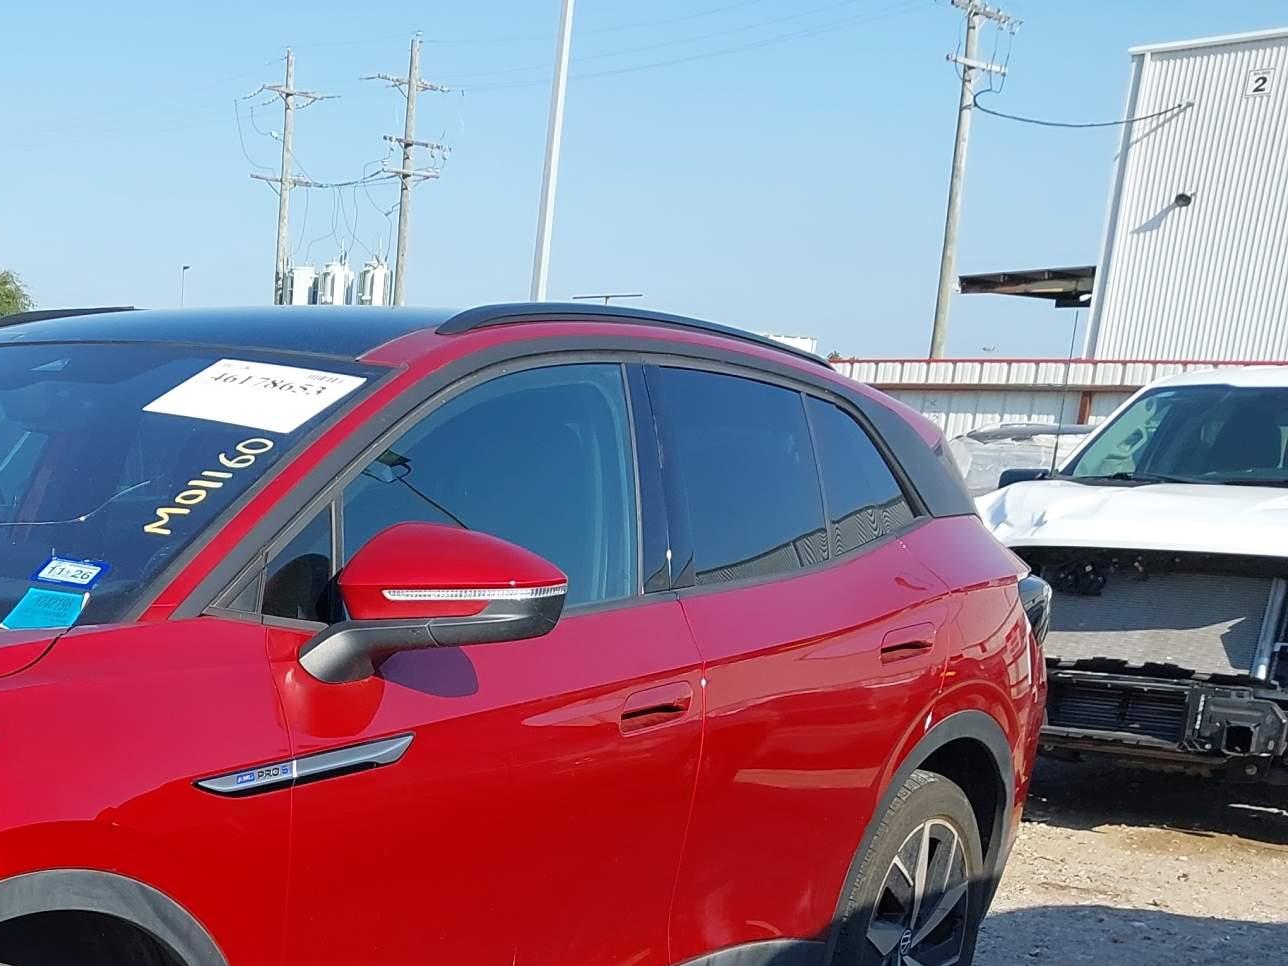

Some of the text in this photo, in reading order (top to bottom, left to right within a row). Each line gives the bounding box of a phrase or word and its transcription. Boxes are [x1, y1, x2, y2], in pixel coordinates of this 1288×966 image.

[1252, 76, 1268, 93] 2
[70, 569, 93, 580] 26
[257, 767, 280, 779] PRO
